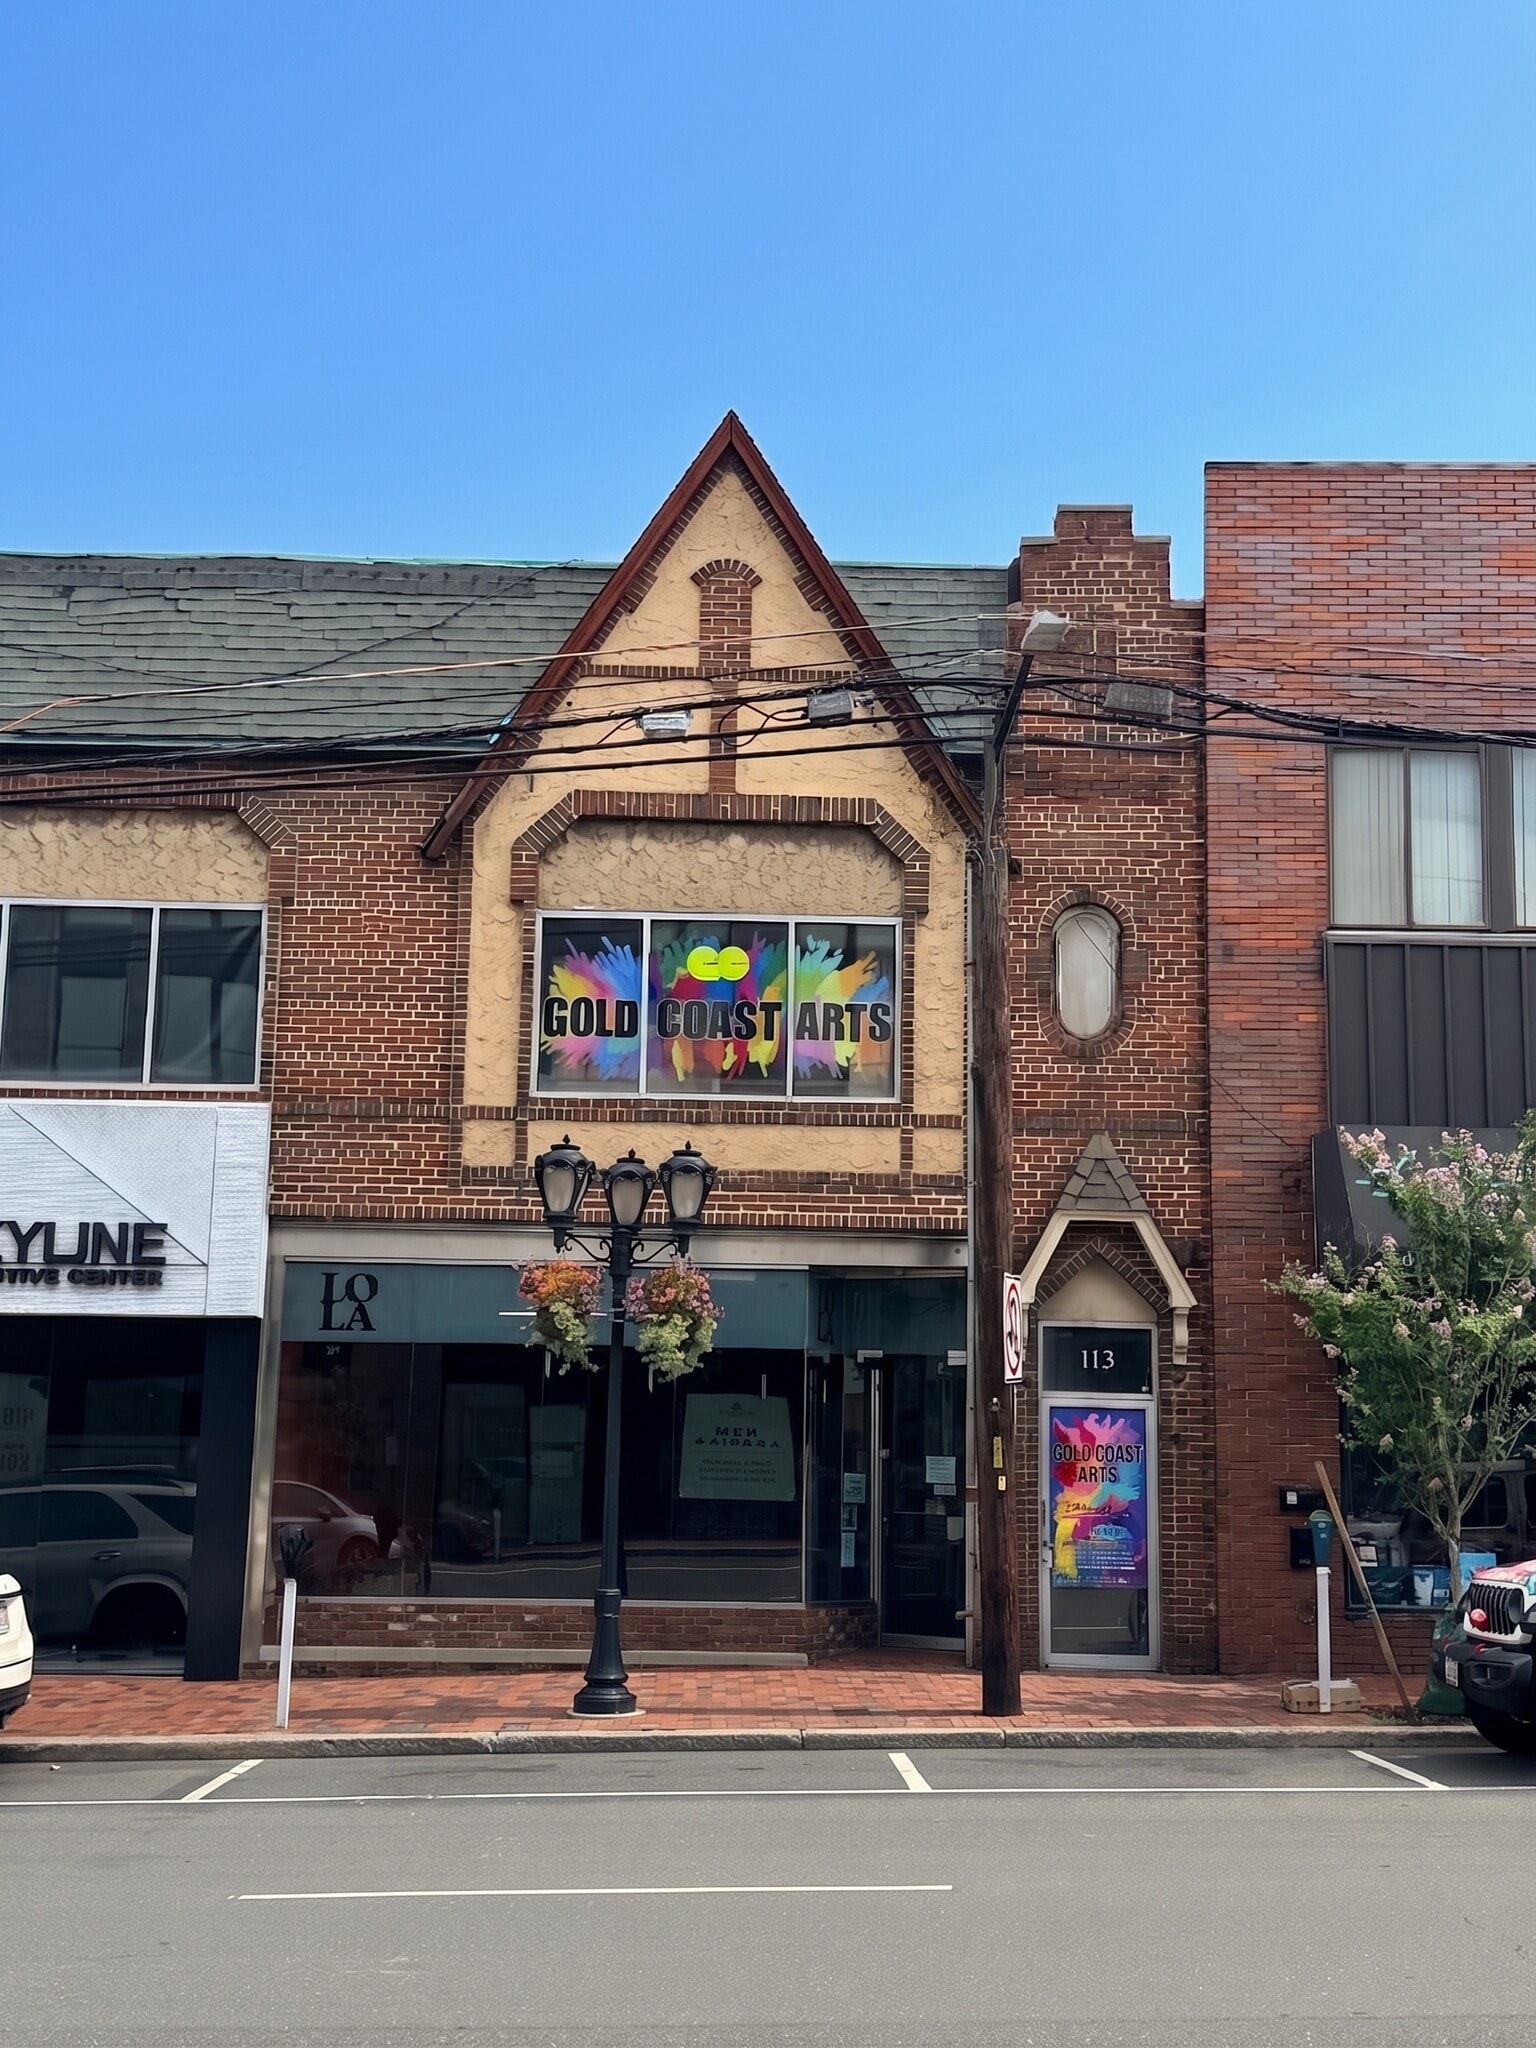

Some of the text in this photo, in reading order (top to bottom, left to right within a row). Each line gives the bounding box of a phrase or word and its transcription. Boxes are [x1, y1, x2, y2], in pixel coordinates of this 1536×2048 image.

[543, 996, 893, 1042] GOLD COAST ARTS
[67, 1268, 163, 1286] CENTER
[1081, 1349, 1115, 1370] 113
[1053, 1443, 1143, 1465] GOLD COAST
[1077, 1465, 1119, 1484] ARTS
